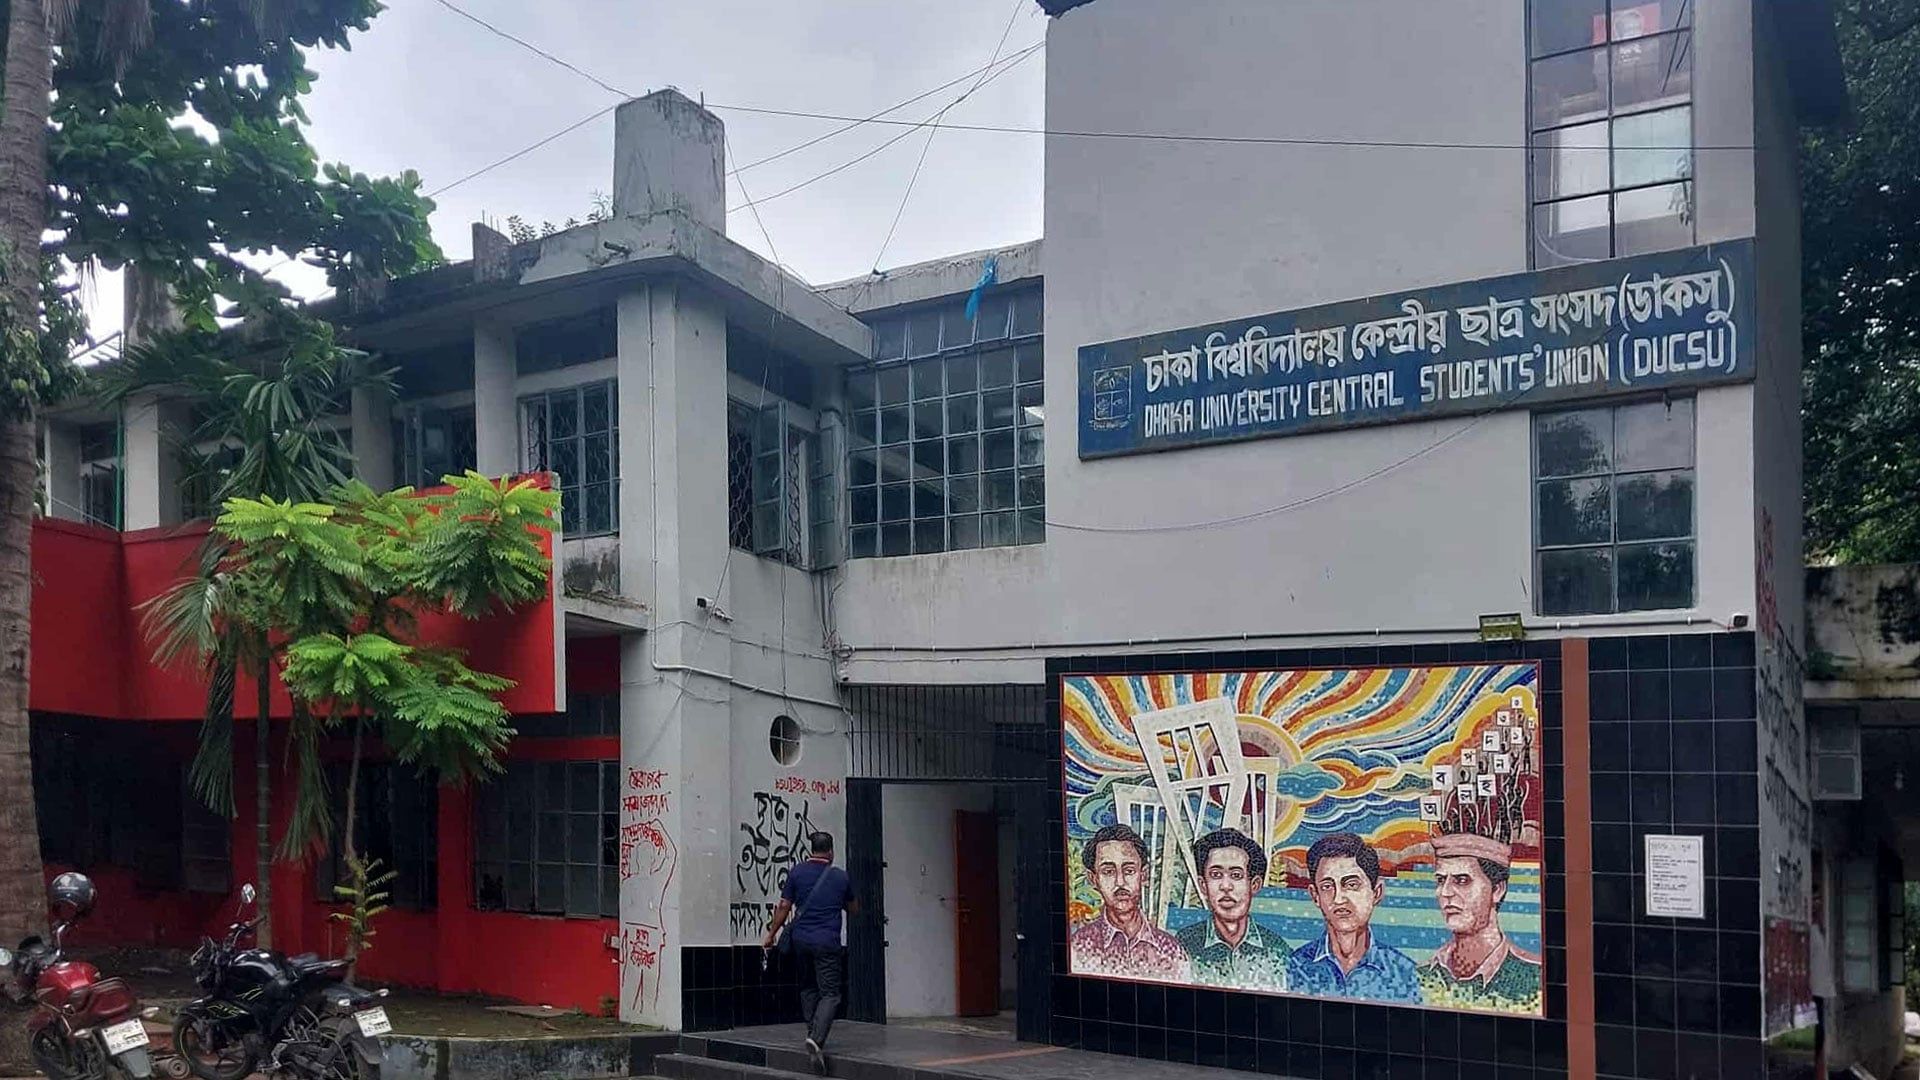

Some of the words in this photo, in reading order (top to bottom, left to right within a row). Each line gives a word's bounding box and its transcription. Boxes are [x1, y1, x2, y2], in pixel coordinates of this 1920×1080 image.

[1142, 344, 1200, 393] ঢাকা
[1204, 325, 1346, 381] বিশ্ববিদ্যালয়
[1351, 299, 1448, 359] কেন্দ্রীয়
[1457, 297, 1525, 346] ছাত্র
[1144, 399, 1194, 438] DHAKA
[1201, 383, 1301, 430] UNIVERSITY
[1307, 370, 1405, 416] CENTRAL
[1545, 343, 1610, 388] UNION
[1619, 319, 1736, 385] (DUCSU)
